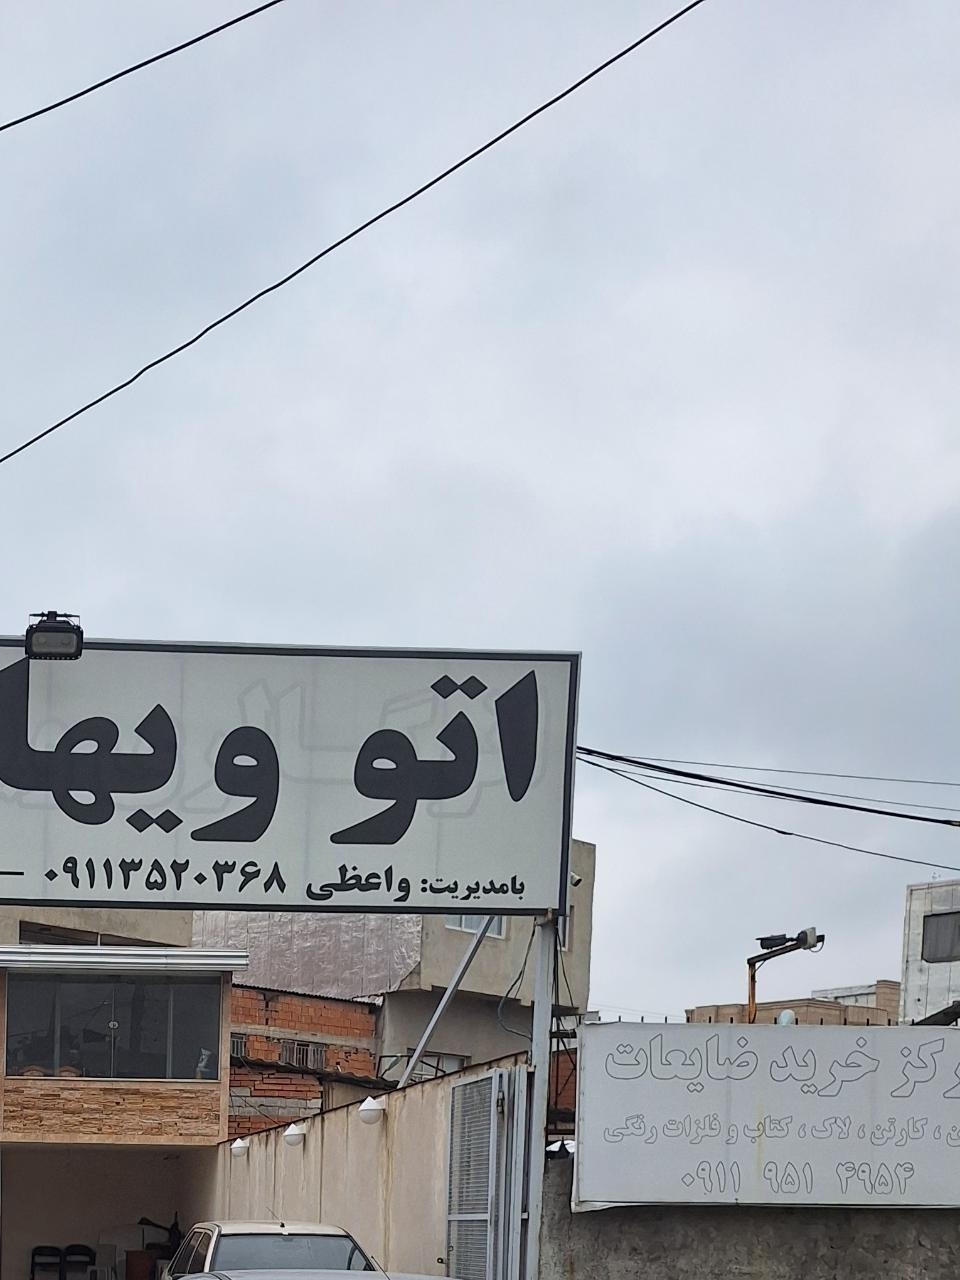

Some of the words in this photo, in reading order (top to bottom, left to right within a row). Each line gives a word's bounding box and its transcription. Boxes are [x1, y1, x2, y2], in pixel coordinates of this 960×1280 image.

[330, 670, 539, 845] اتو
[44, 854, 287, 894] ۰۹۱۱۳۵۲۰۳۶۸
[306, 863, 411, 902] واعظی
[420, 874, 525, 900] بامدیریت:
[604, 1033, 759, 1094] ضایعات
[769, 1036, 881, 1097] خرید
[603, 1113, 658, 1145] رنگی
[662, 1112, 722, 1145] فلزات
[724, 1123, 739, 1145] و
[742, 1114, 793, 1144] کتاب
[681, 1160, 741, 1194] ۰۹۱۱
[762, 1160, 814, 1194] ۹۵۱
[835, 1160, 915, 1195] ۴۹۵۴
